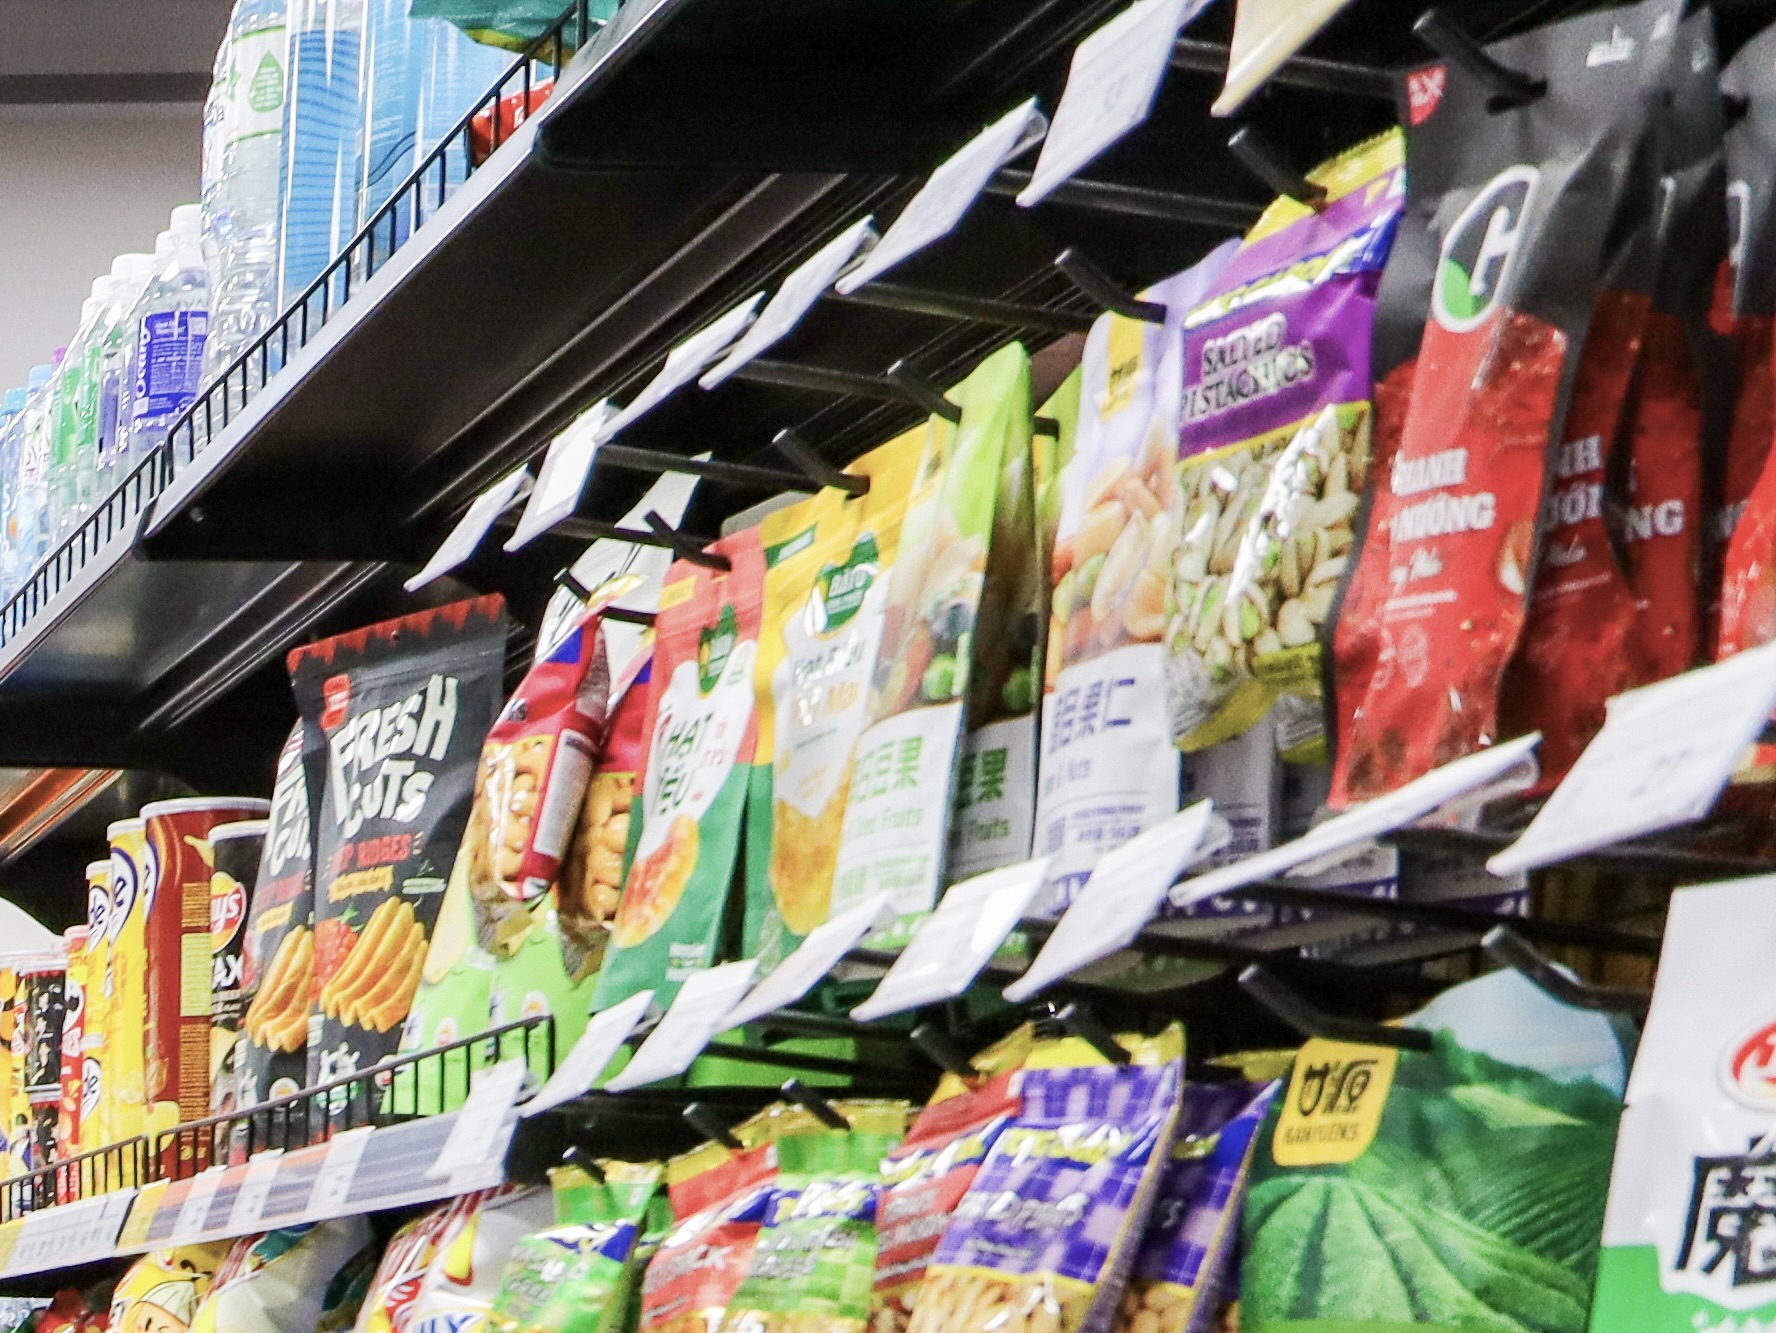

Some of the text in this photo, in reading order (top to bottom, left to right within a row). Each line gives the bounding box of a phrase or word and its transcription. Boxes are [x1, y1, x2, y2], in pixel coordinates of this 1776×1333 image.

[1202, 312, 1287, 376] SALTED
[330, 675, 458, 815] FRESH
[345, 756, 433, 839] CUTS
